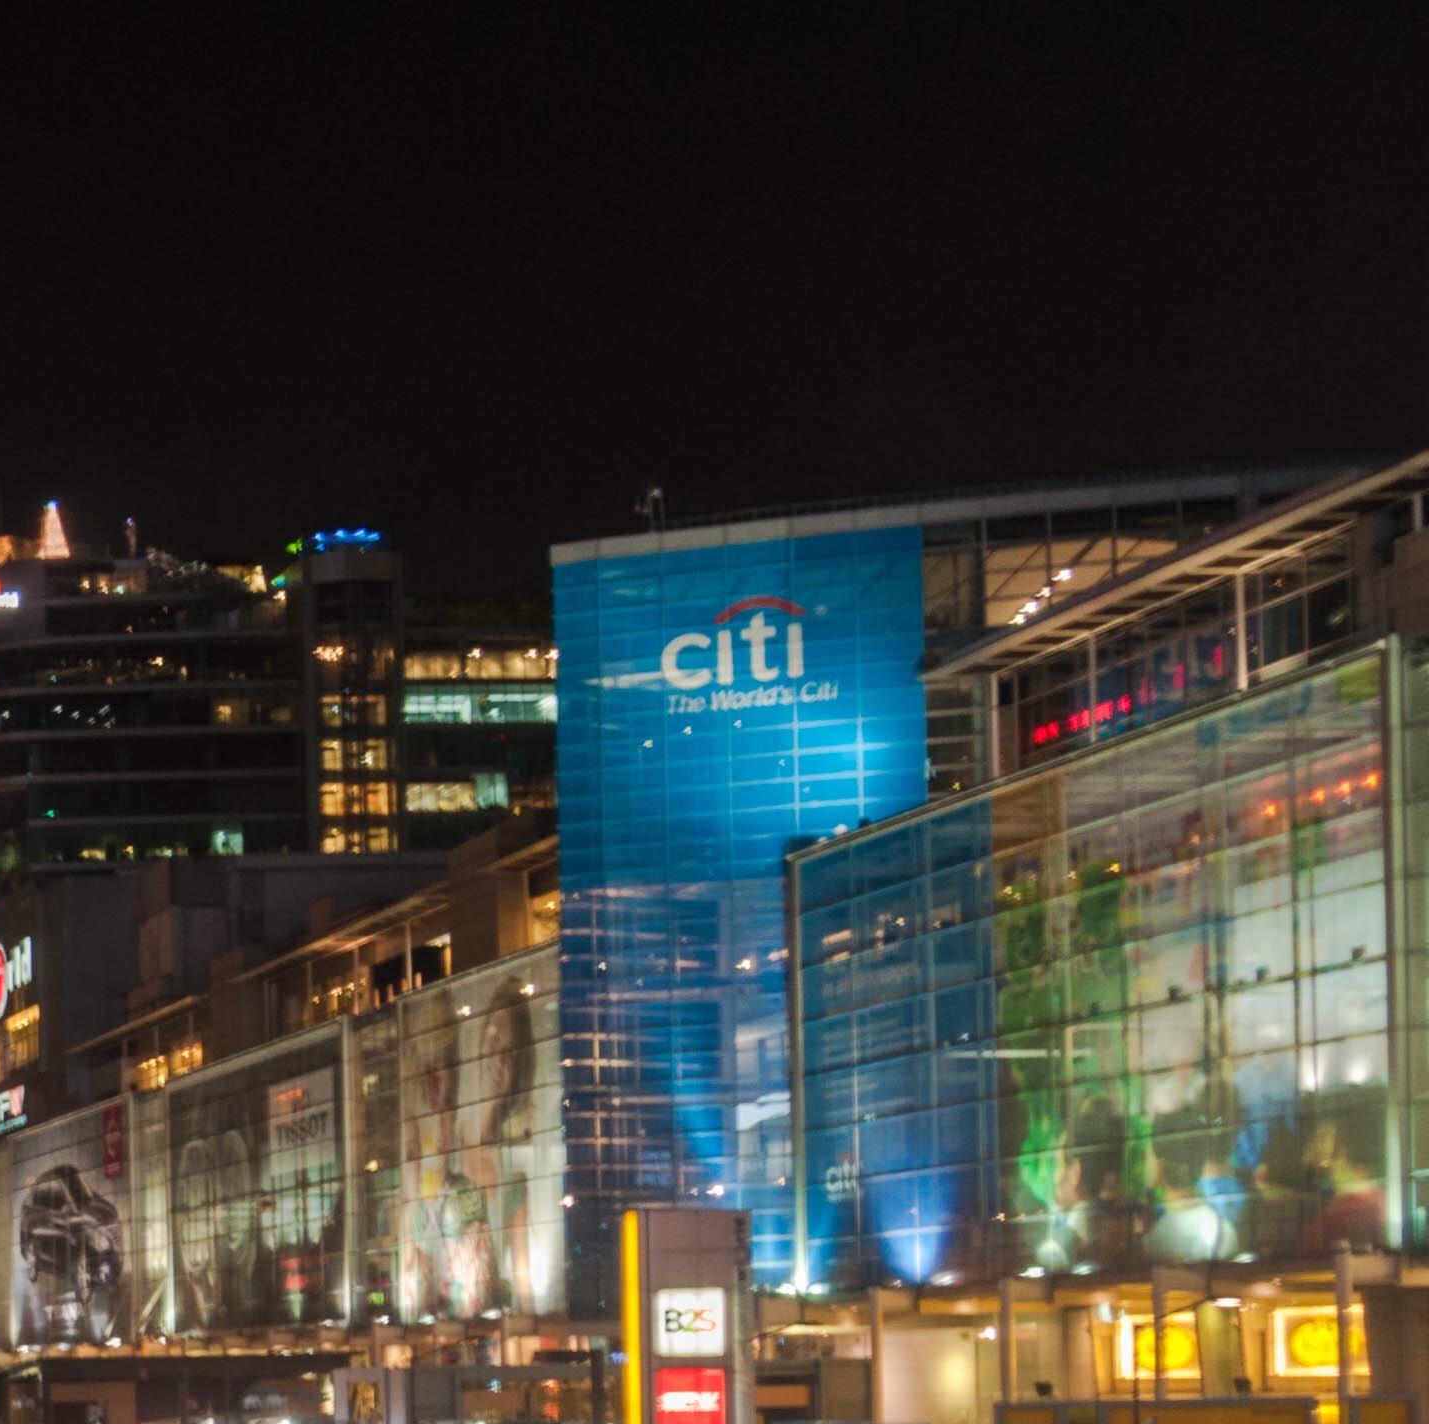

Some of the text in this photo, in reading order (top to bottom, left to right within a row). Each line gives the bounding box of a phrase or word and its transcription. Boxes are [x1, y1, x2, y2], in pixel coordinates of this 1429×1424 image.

[661, 611, 805, 690] citi
[667, 694, 706, 715] The
[709, 685, 796, 712] World's
[275, 1111, 329, 1147] TISSOT
[664, 1308, 718, 1333] B2S
